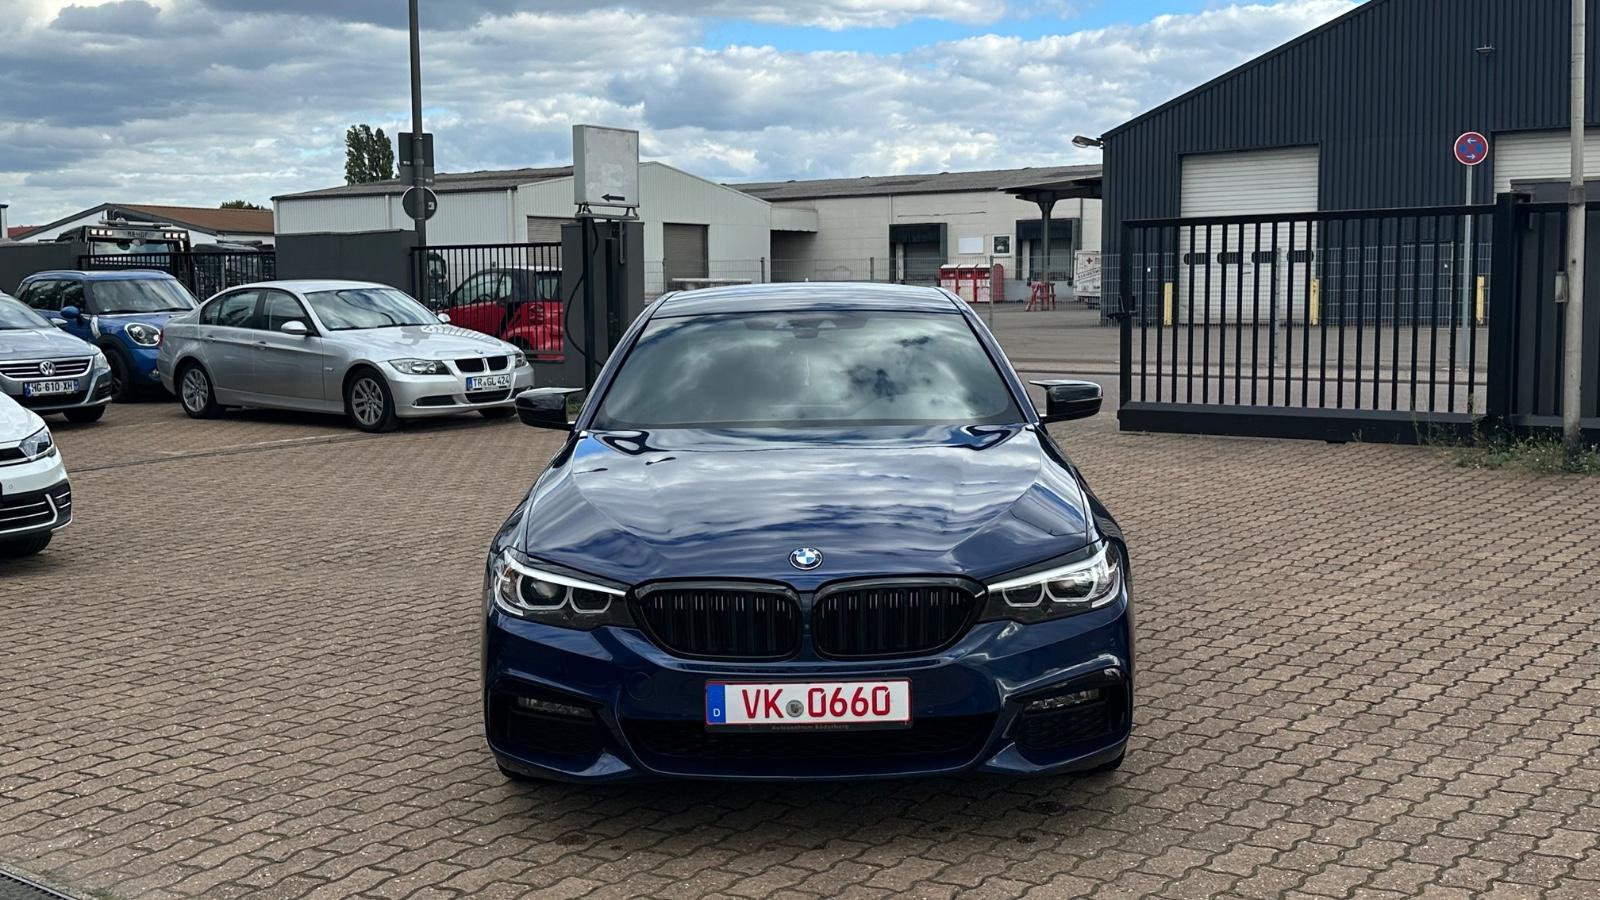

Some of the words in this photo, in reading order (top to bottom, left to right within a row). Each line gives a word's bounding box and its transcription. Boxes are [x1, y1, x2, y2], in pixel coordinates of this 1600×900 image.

[473, 378, 482, 387] TR
[487, 377, 496, 386] GL
[741, 688, 784, 719] VK
[807, 686, 891, 718] 0660
[713, 708, 720, 717] D
